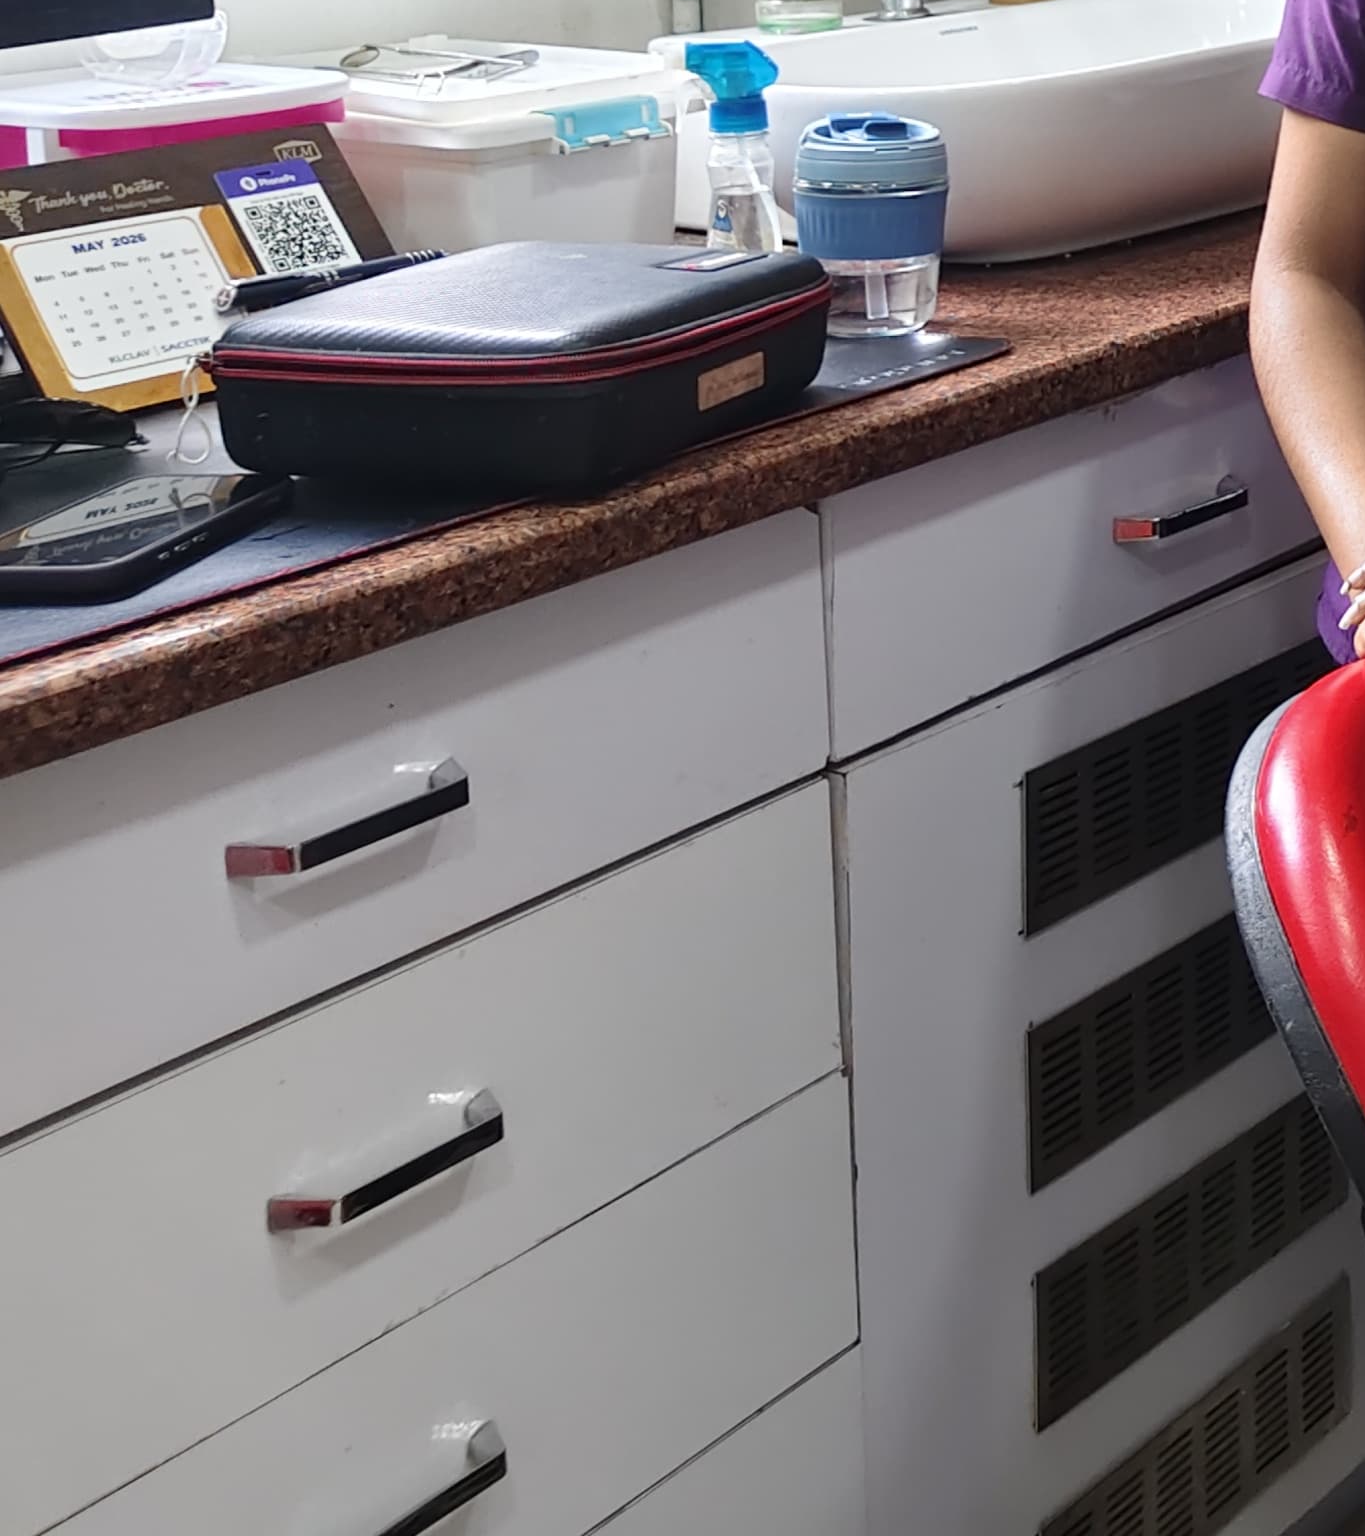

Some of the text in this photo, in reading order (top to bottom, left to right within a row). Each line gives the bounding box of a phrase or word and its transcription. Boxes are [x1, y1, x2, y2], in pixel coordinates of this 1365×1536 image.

[281, 145, 314, 160] KLM
[29, 191, 77, 214] Thank
[78, 189, 112, 207] you,
[72, 233, 147, 254] MAY 2026
[34, 274, 55, 283] Mon
[61, 270, 79, 279] Tue
[84, 265, 106, 273] Wed
